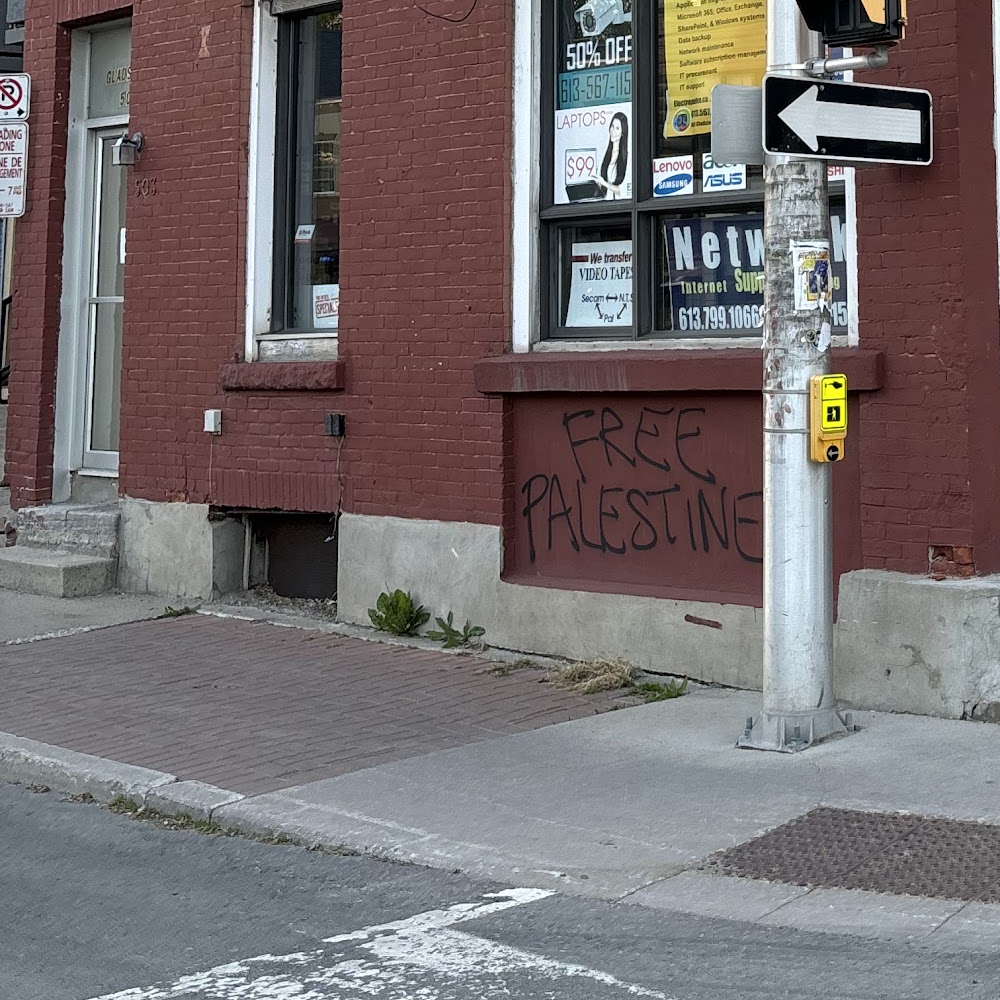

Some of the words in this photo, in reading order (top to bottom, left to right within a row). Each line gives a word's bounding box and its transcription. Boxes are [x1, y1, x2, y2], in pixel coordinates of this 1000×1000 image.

[677, 10, 702, 20] Microsoft
[715, 16, 738, 25] Windows
[740, 13, 765, 22] systems
[692, 33, 711, 43] backup
[566, 40, 601, 71] 50%
[605, 35, 632, 65] OFF
[679, 46, 700, 55] Network
[702, 41, 734, 52] maintenance
[680, 57, 702, 67] Software
[704, 52, 736, 63] subscription
[106, 67, 131, 84] GLADS
[686, 67, 717, 79] procurement
[561, 71, 631, 103] 613-567-115
[686, 81, 704, 90] support
[557, 110, 606, 130] LAPTOPS
[0, 129, 22, 139] ADING
[12, 157, 21, 167] DE
[567, 156, 594, 179] $99
[653, 159, 693, 174] Lenovo
[0, 168, 22, 178] GEMENT
[704, 172, 742, 188] ASUS
[657, 179, 688, 191] SAMSUNG
[590, 253, 602, 264] We
[580, 267, 608, 281] VIDEO
[681, 280, 727, 294] Internet
[581, 294, 604, 302] Secam
[604, 314, 614, 323] Pal
[562, 406, 716, 484] FREE
[522, 474, 763, 564] PALESTINE
